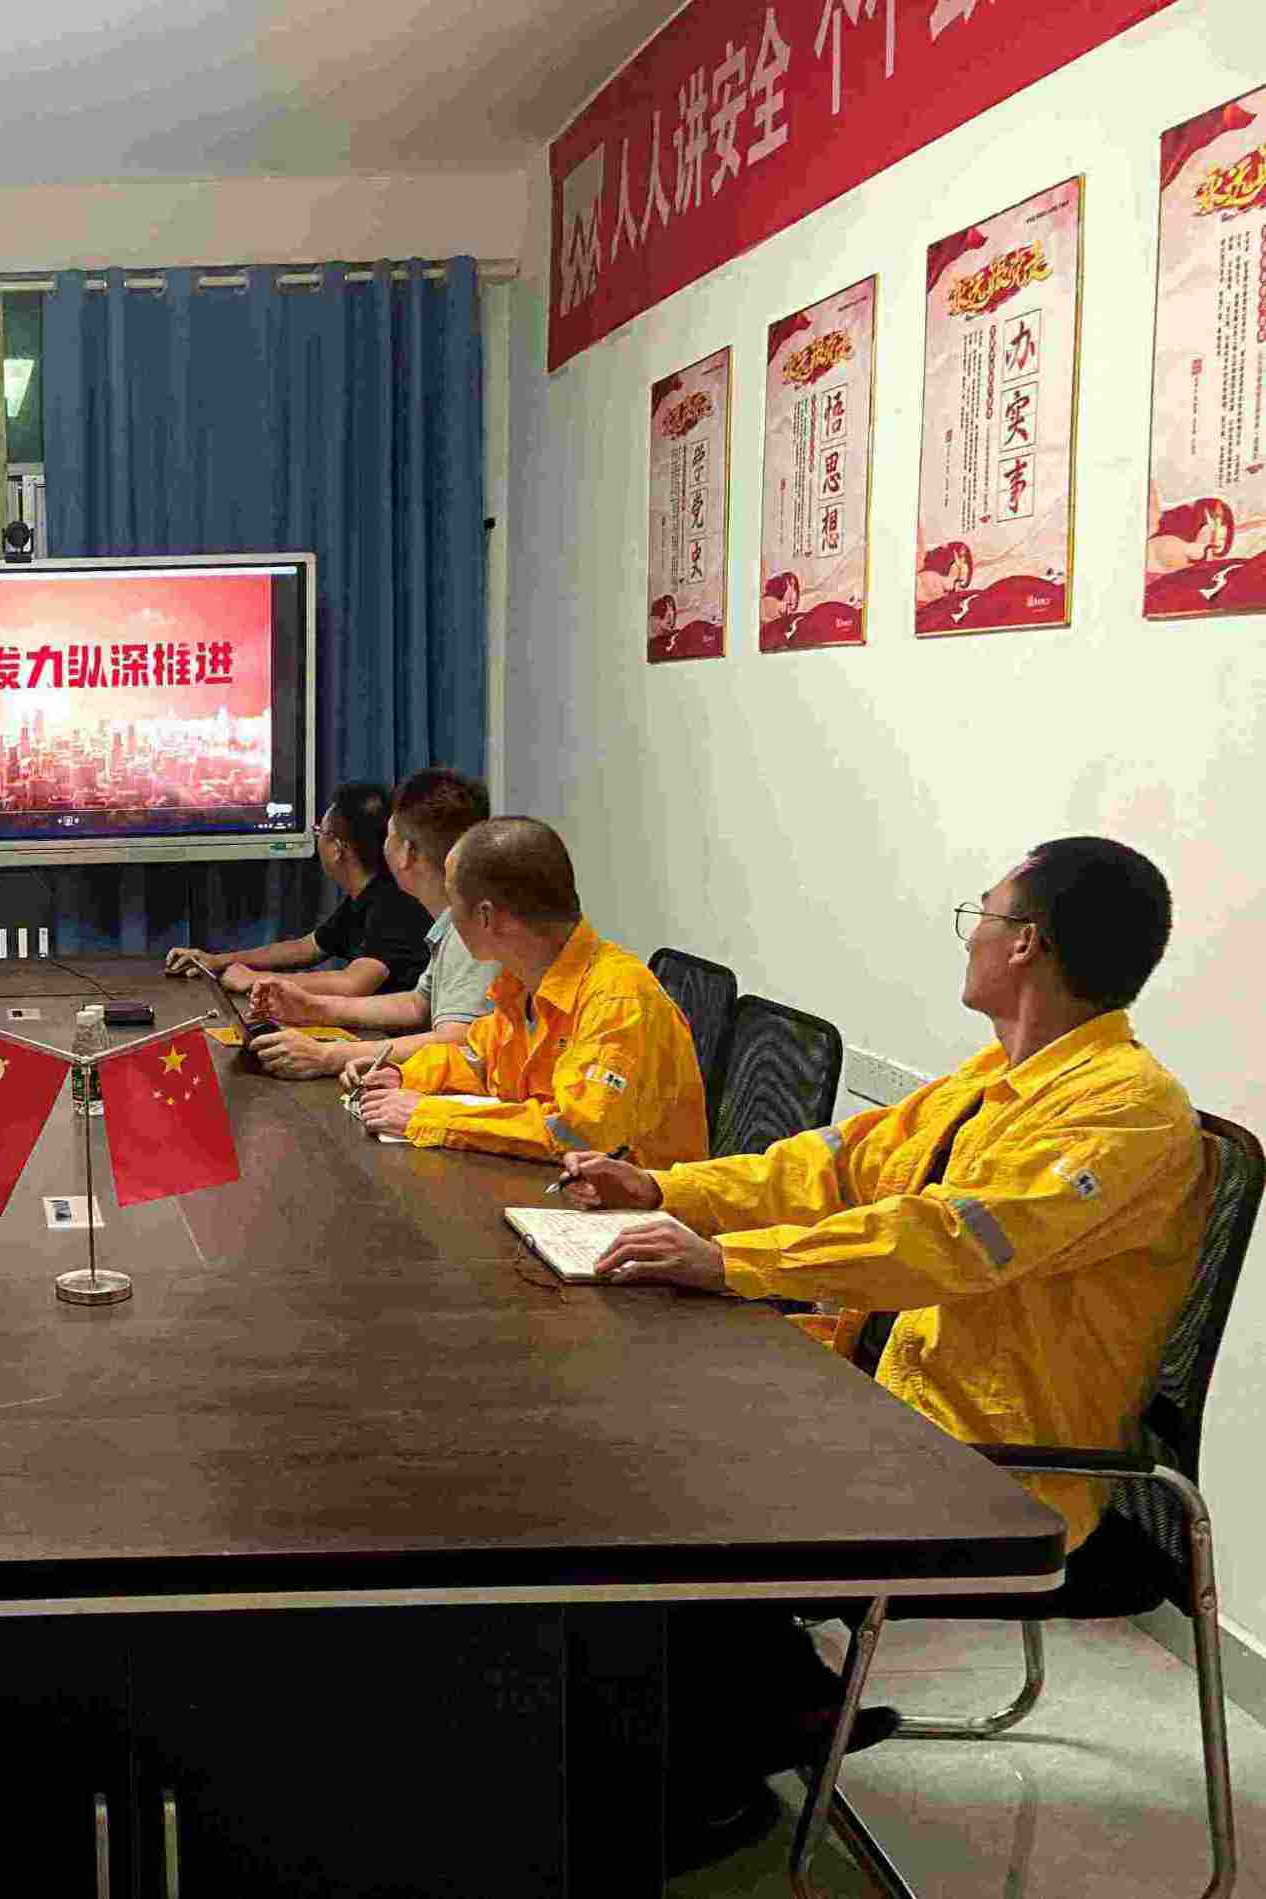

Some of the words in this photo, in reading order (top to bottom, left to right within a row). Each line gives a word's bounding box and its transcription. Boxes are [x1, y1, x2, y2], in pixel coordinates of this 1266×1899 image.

[610, 8, 791, 265] 人人讲安全
[1004, 320, 1037, 514] 办实事
